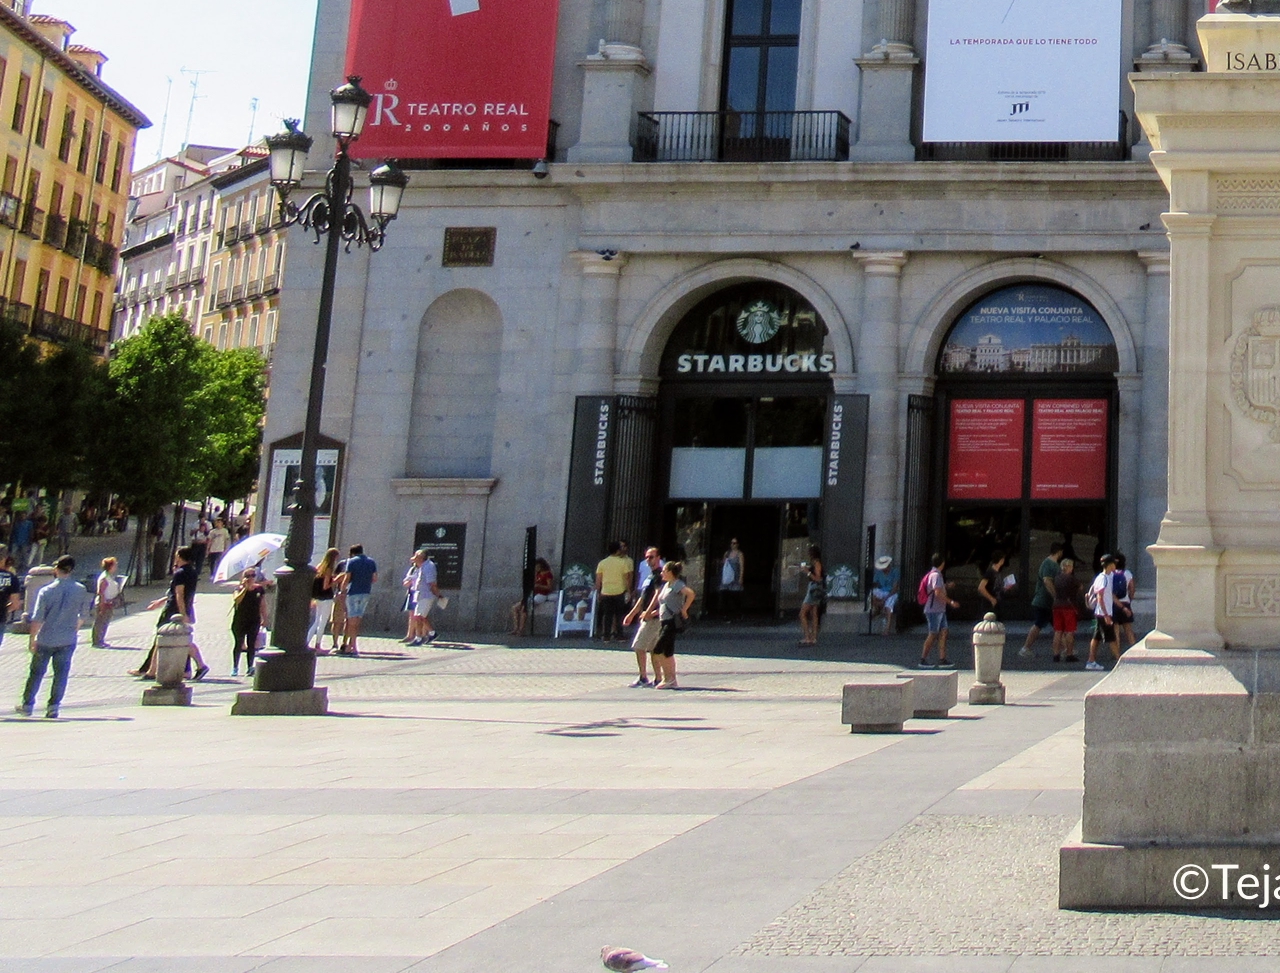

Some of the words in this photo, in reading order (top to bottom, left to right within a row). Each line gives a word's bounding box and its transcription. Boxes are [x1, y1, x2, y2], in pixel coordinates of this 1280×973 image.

[407, 103, 477, 116] TEATRO
[483, 103, 529, 116] REAL
[980, 307, 1009, 315] NUEVA
[1011, 307, 1037, 315] VISITA
[1038, 307, 1084, 315] CONJUNTA
[970, 315, 1003, 324] TEATRO
[1004, 315, 1026, 323] REAL
[1028, 315, 1033, 323] Y
[1034, 315, 1070, 323] PALACIO
[1071, 315, 1093, 323] REAL
[677, 354, 835, 373] STARBUCKS
[594, 403, 609, 485] STARBUCKS
[828, 404, 843, 486] STARBUCKS
